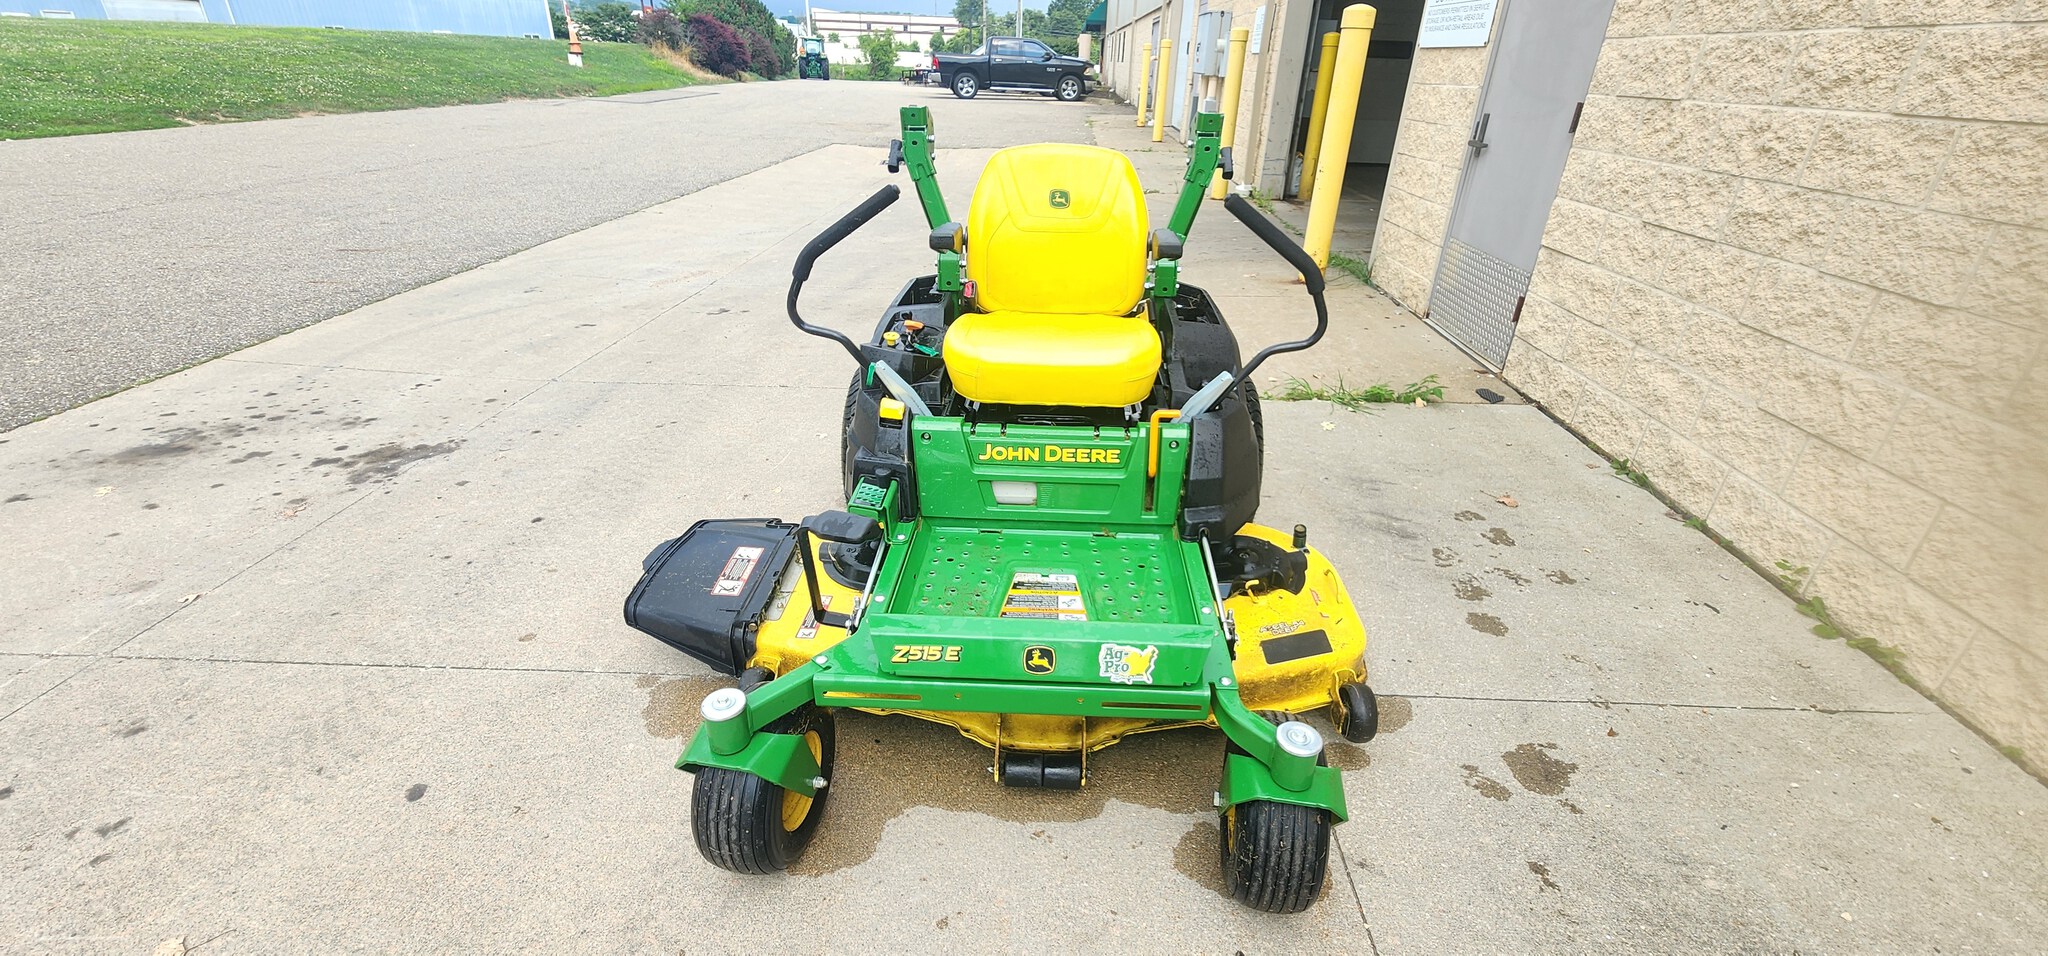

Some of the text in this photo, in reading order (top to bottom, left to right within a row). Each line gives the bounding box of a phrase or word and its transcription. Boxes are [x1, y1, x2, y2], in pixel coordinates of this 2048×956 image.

[978, 443, 1121, 463] JOHN DEERE
[1103, 647, 1129, 662] Ag-
[1104, 660, 1129, 673] Pro
